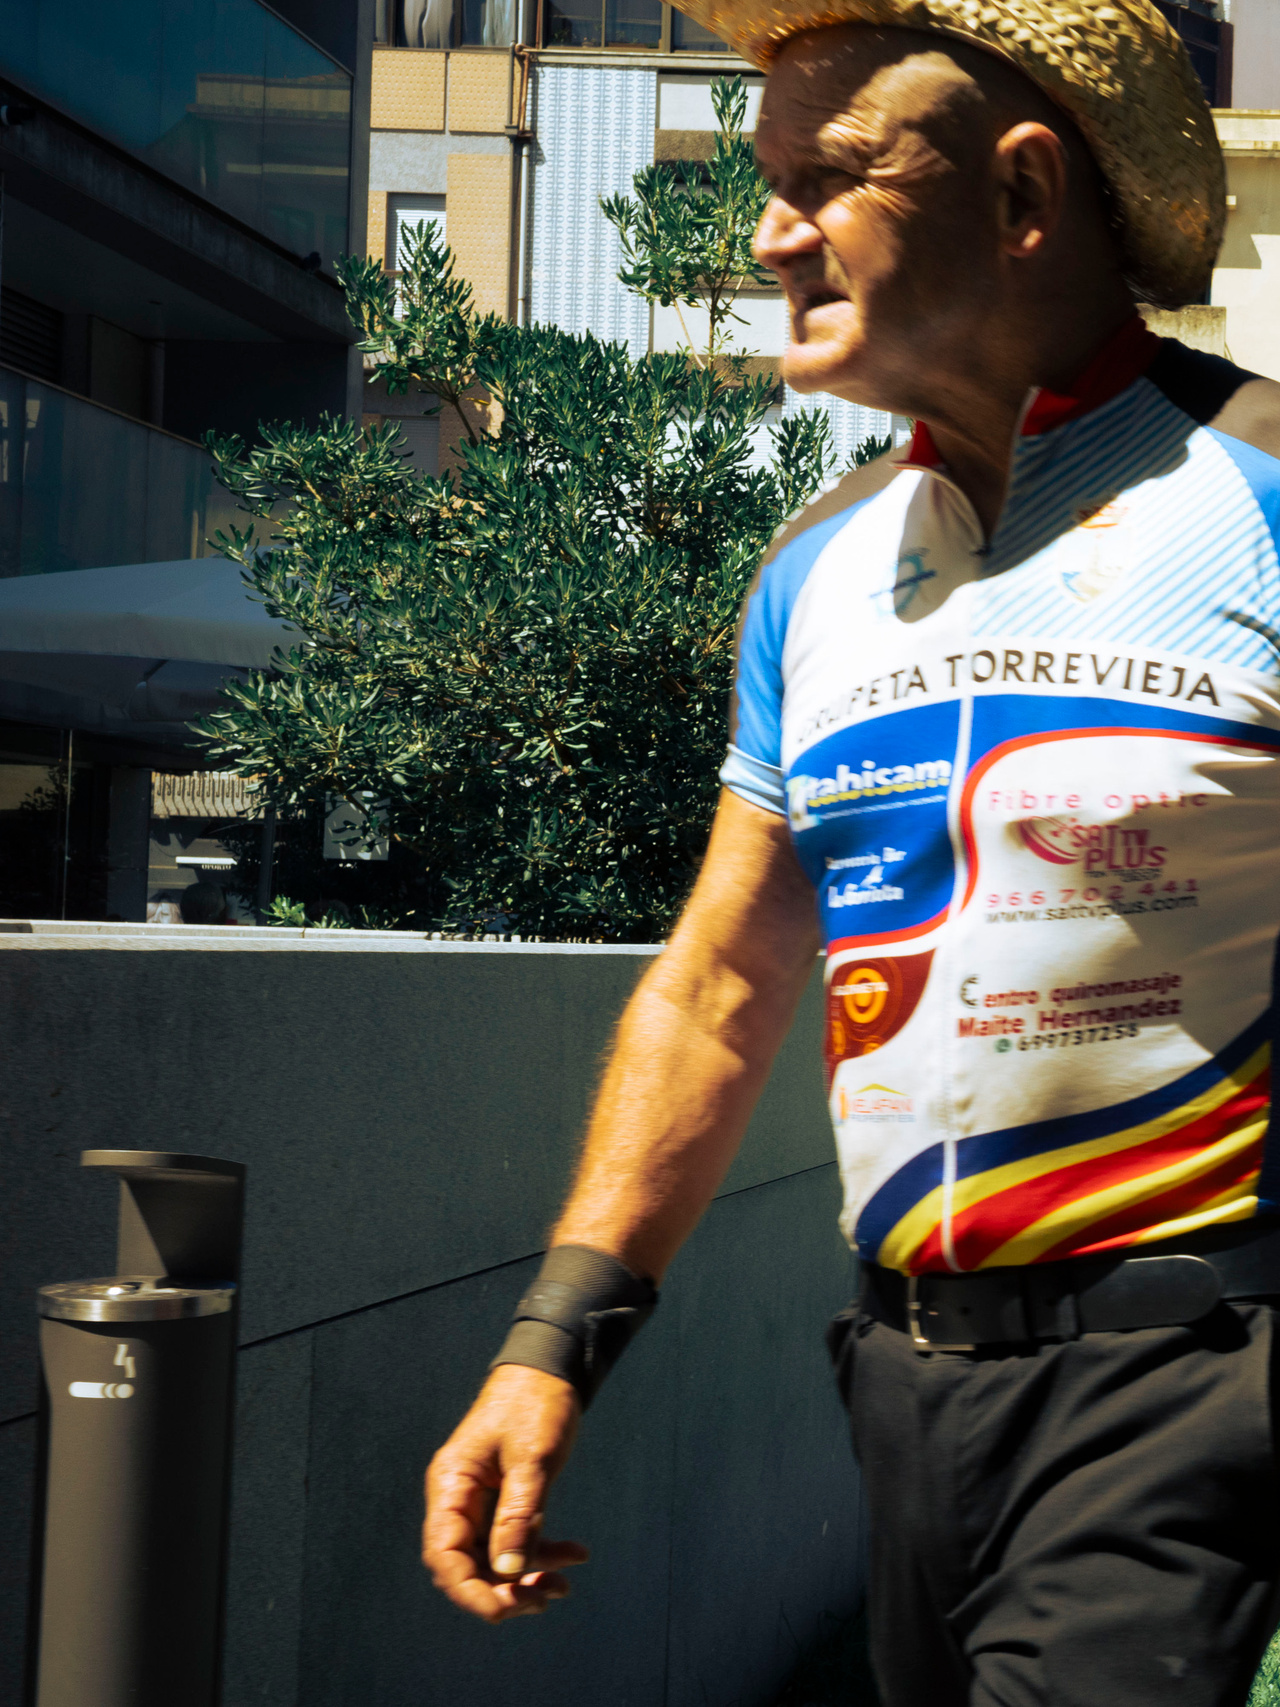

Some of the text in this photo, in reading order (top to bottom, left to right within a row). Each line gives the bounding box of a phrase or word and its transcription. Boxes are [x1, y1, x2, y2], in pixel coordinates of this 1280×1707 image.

[945, 650, 1222, 707] TORREVIEJA
[1103, 791, 1209, 814] optic
[1084, 846, 1169, 870] PLUS
[986, 879, 1199, 908] 966 702 441
[1051, 972, 1183, 1007] quiromasaje
[956, 998, 1183, 1038] Maite Hernandez
